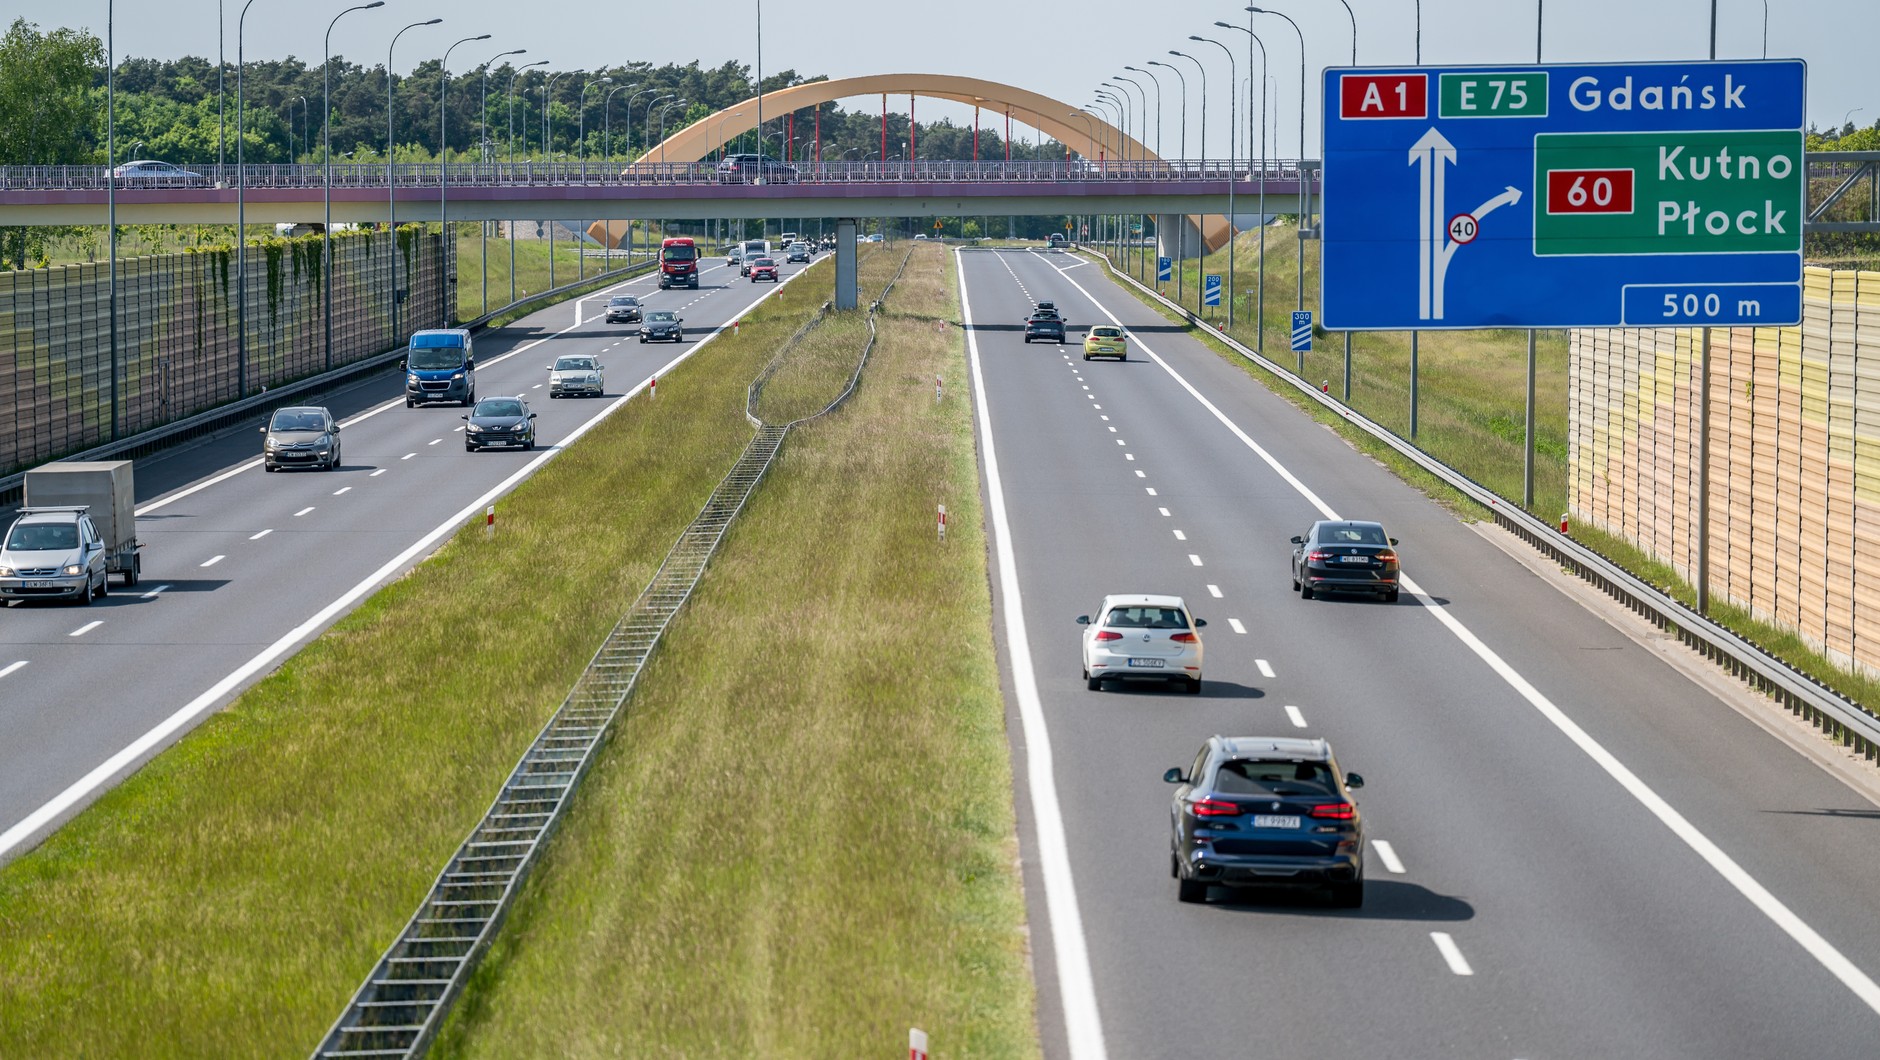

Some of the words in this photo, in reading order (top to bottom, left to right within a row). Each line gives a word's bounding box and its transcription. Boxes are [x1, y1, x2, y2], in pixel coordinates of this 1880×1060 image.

[1488, 80, 1528, 110] 75
[1568, 74, 1747, 112] Gdańsk
[1658, 145, 1793, 181] Kutno
[1567, 176, 1613, 207] 60
[1452, 221, 1475, 237] 40
[1658, 200, 1787, 236] Płock
[1662, 293, 1721, 317] 500
[1737, 300, 1761, 317] m
